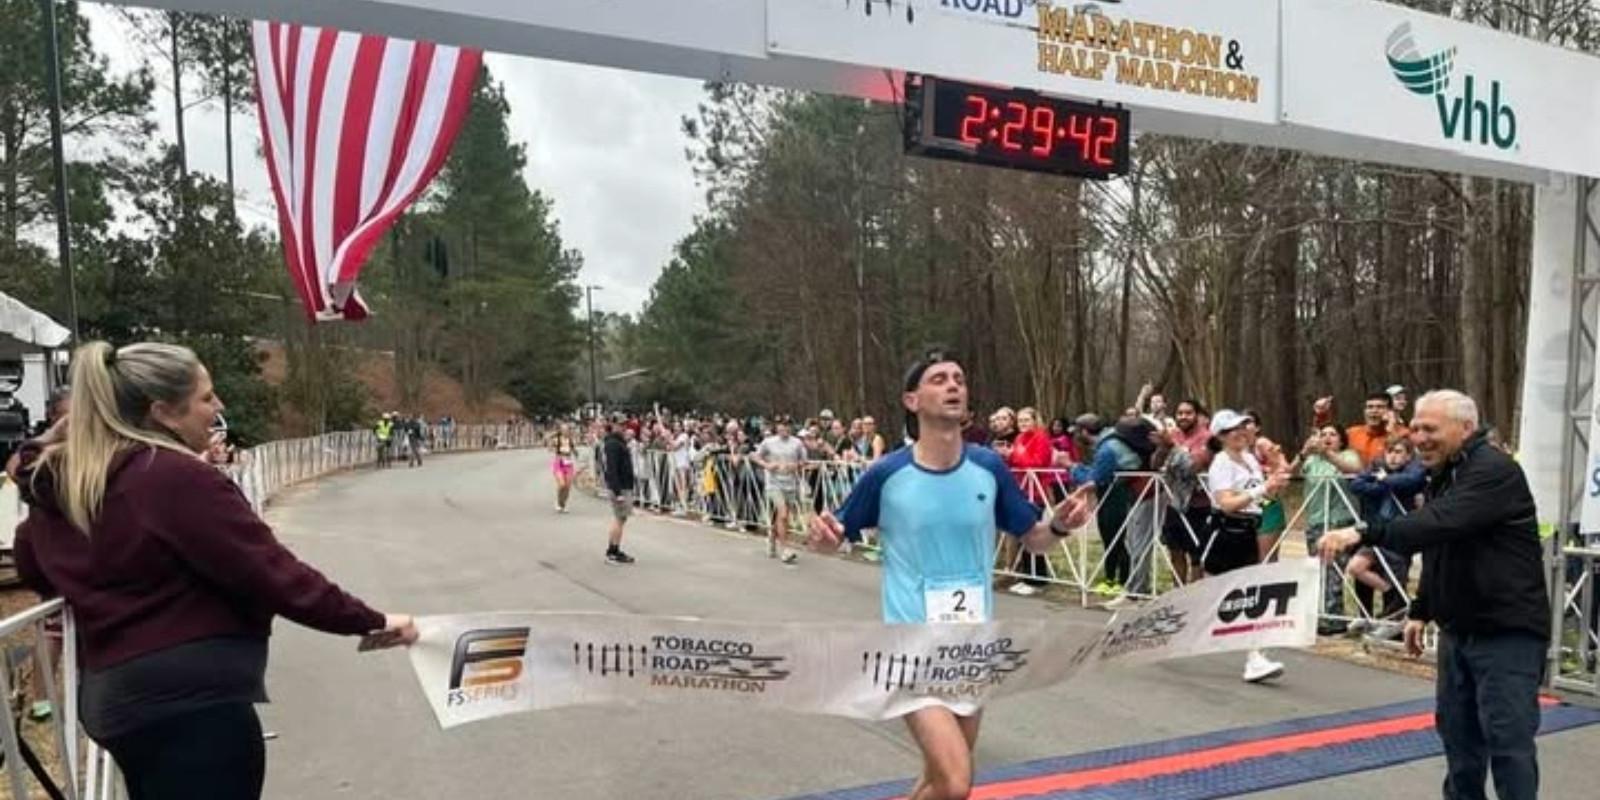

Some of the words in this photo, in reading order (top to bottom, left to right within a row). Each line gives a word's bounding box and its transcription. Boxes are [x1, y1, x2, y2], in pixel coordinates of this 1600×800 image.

[1036, 3, 1222, 67] MARATHON
[1225, 39, 1244, 71] &
[1037, 42, 1110, 80] HALF
[1115, 55, 1259, 103] MARATHON
[1436, 75, 1516, 149] vhb
[952, 589, 967, 612] 2
[652, 635, 754, 656] TOBACCO
[652, 655, 710, 671] ROAD
[650, 673, 766, 693] MARATHON
